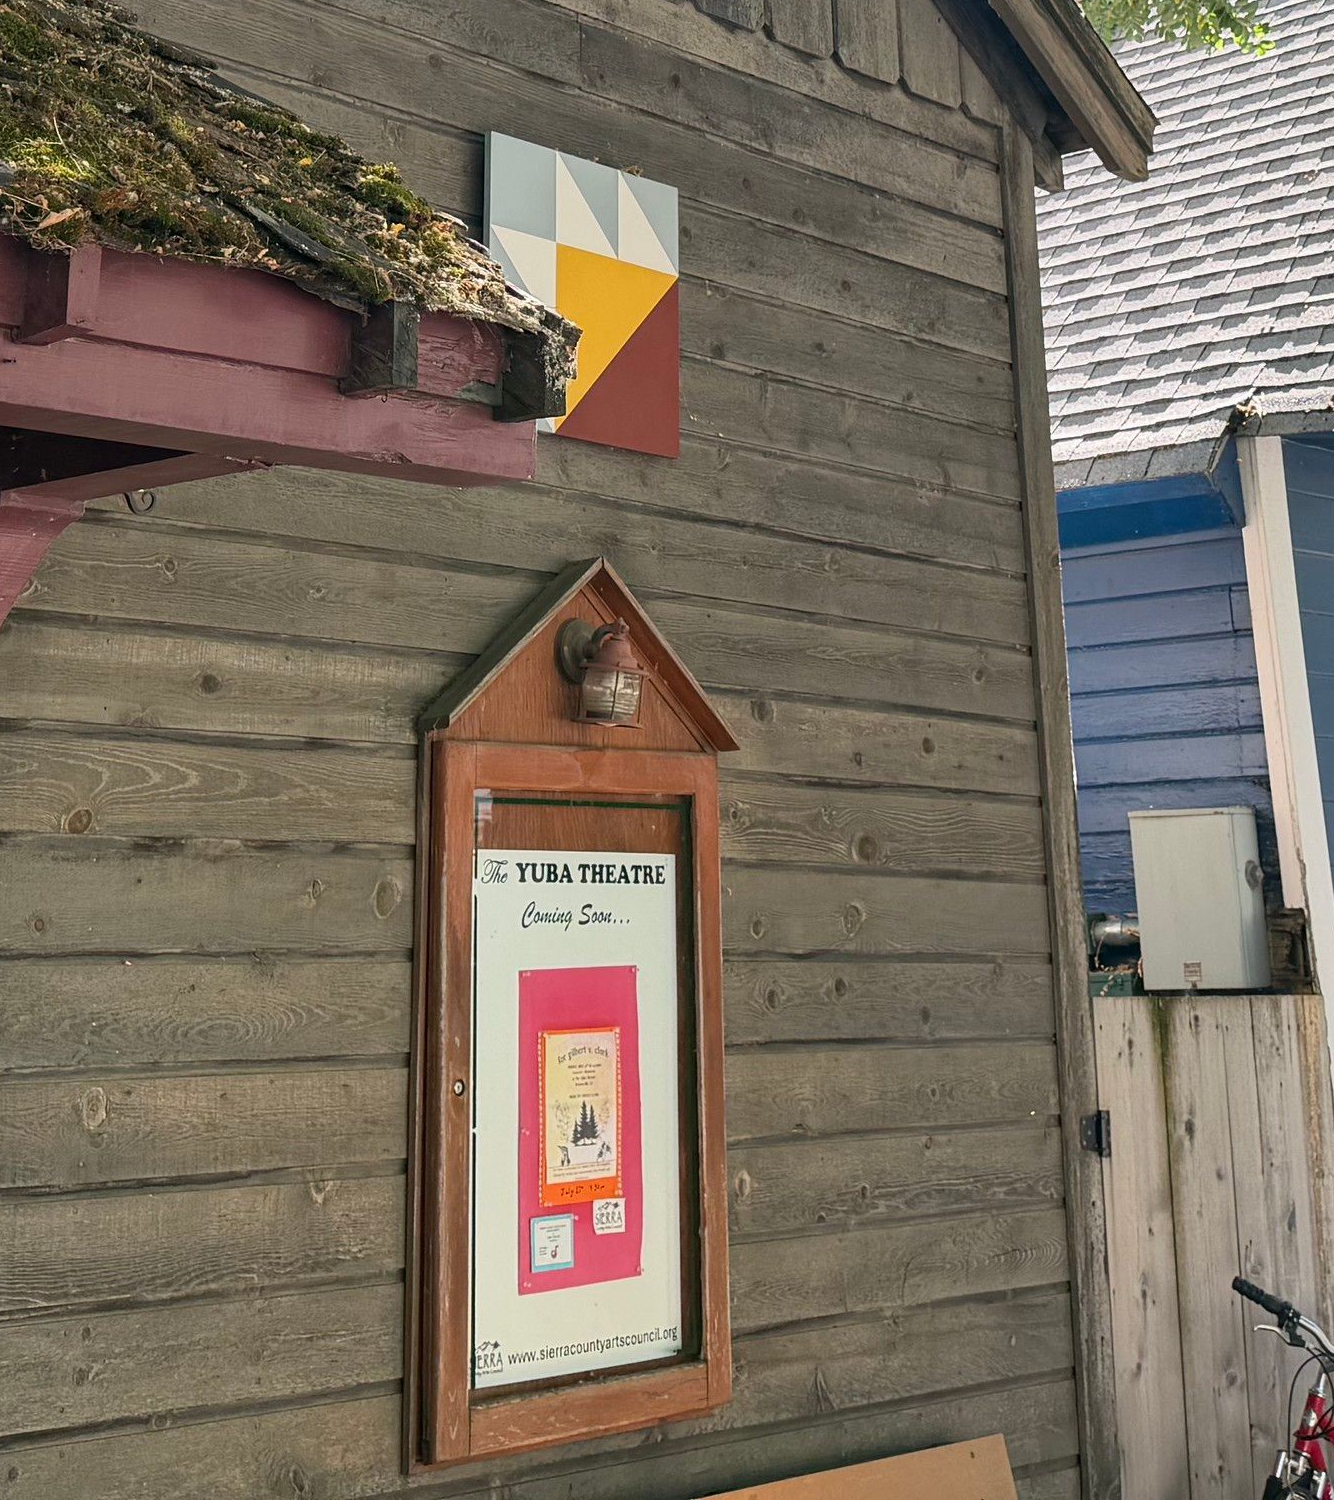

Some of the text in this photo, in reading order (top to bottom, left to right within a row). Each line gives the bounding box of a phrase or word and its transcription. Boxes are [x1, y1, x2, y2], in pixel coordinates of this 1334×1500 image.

[481, 859, 666, 885] The YUBA THEATRE
[522, 901, 573, 931] Coming
[507, 1325, 678, 1365] www.sierracountyartscouncil.org
